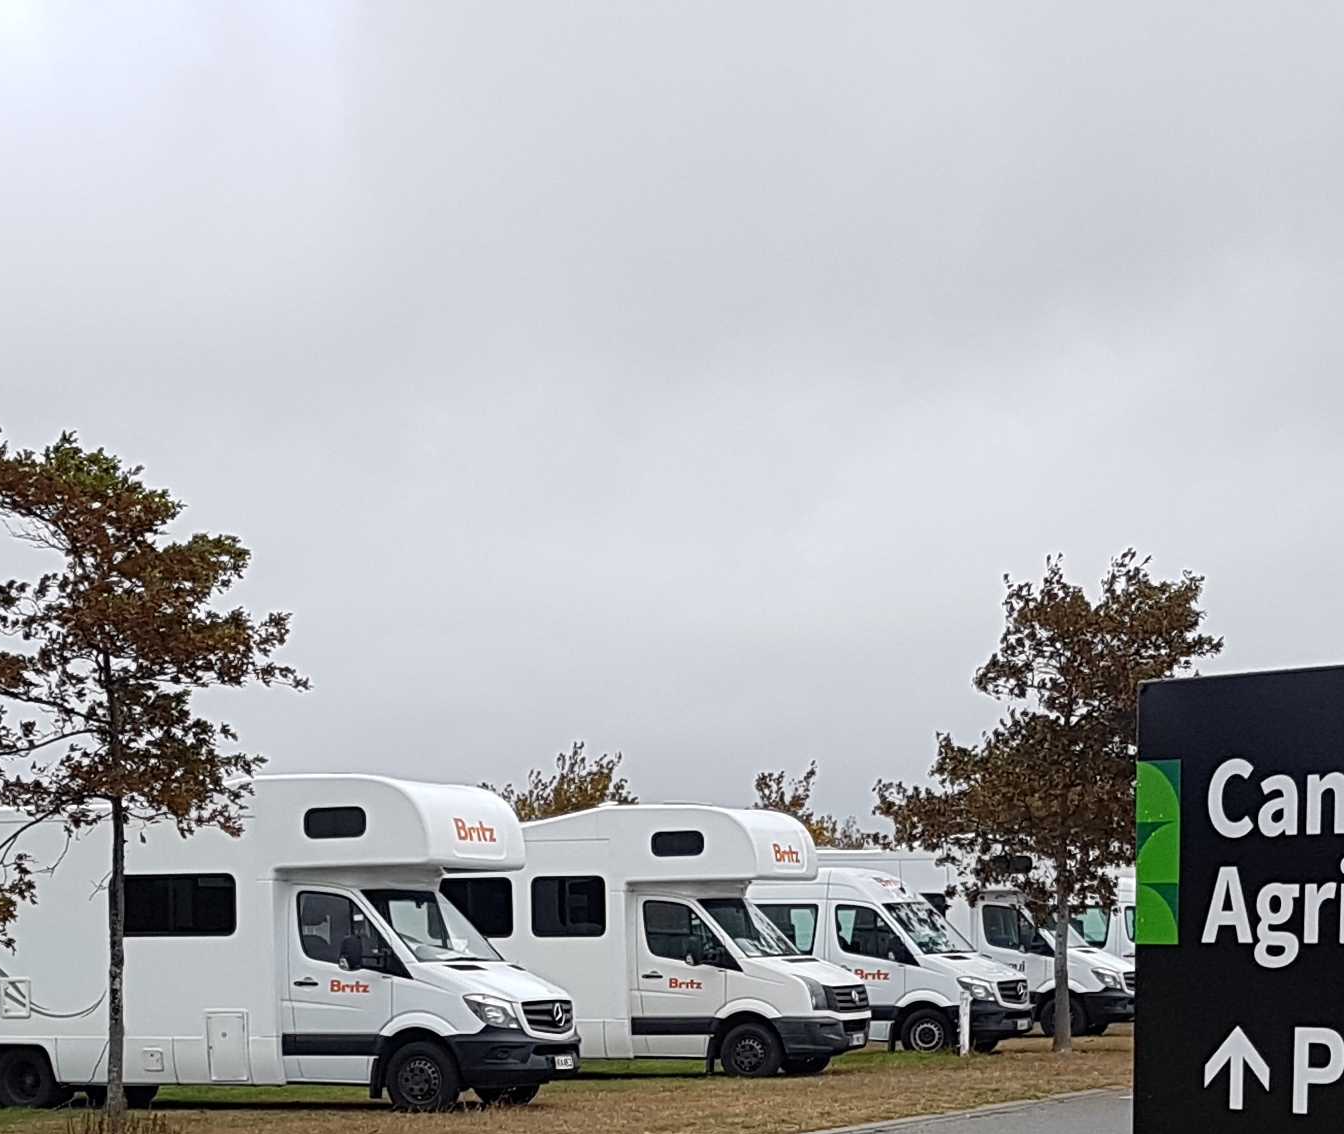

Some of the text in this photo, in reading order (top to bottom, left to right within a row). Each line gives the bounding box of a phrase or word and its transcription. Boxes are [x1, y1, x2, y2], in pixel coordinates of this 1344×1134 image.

[453, 817, 497, 843] Britz
[772, 843, 801, 863] Britz
[855, 968, 890, 981] Britz
[330, 979, 369, 993] Britz
[668, 977, 703, 989] Britz
